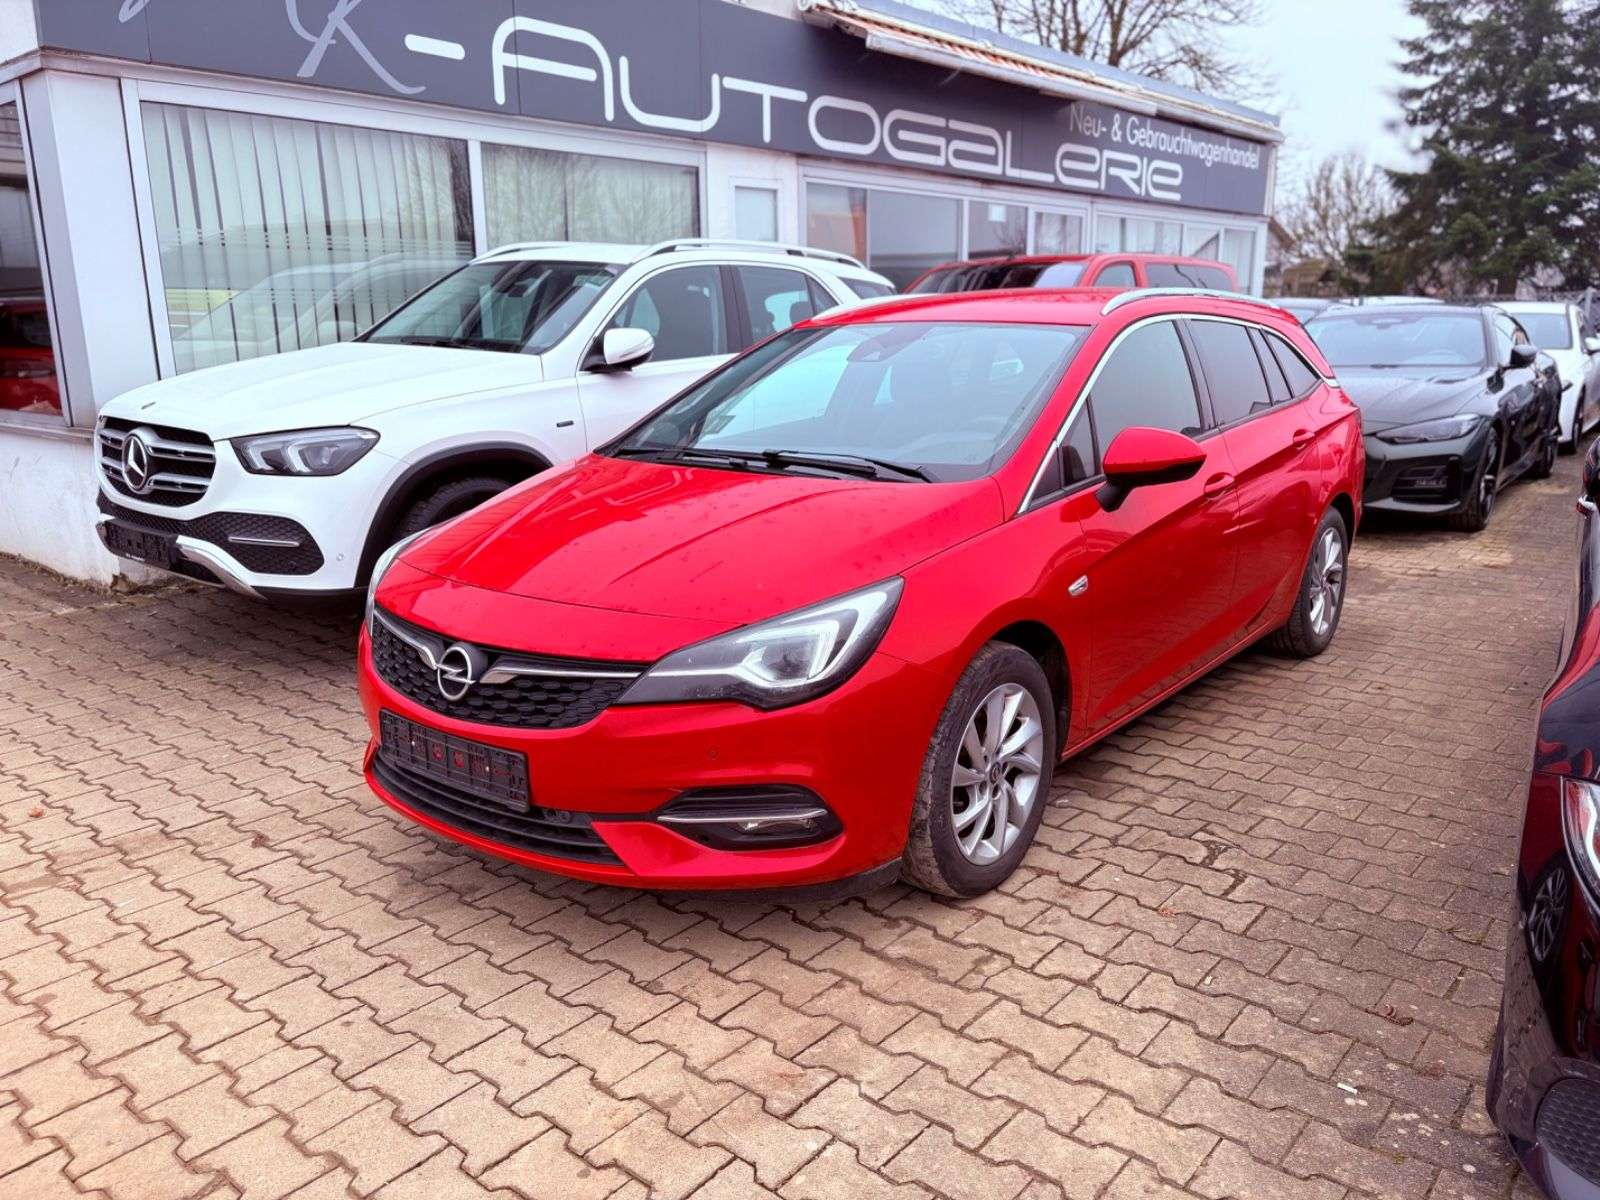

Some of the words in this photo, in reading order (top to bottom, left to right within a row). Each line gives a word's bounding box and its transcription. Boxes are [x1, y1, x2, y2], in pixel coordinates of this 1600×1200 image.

[1069, 102, 1107, 138] Neu-
[1111, 113, 1122, 143] &
[1126, 115, 1260, 169] Gebrauchtwagenhandel
